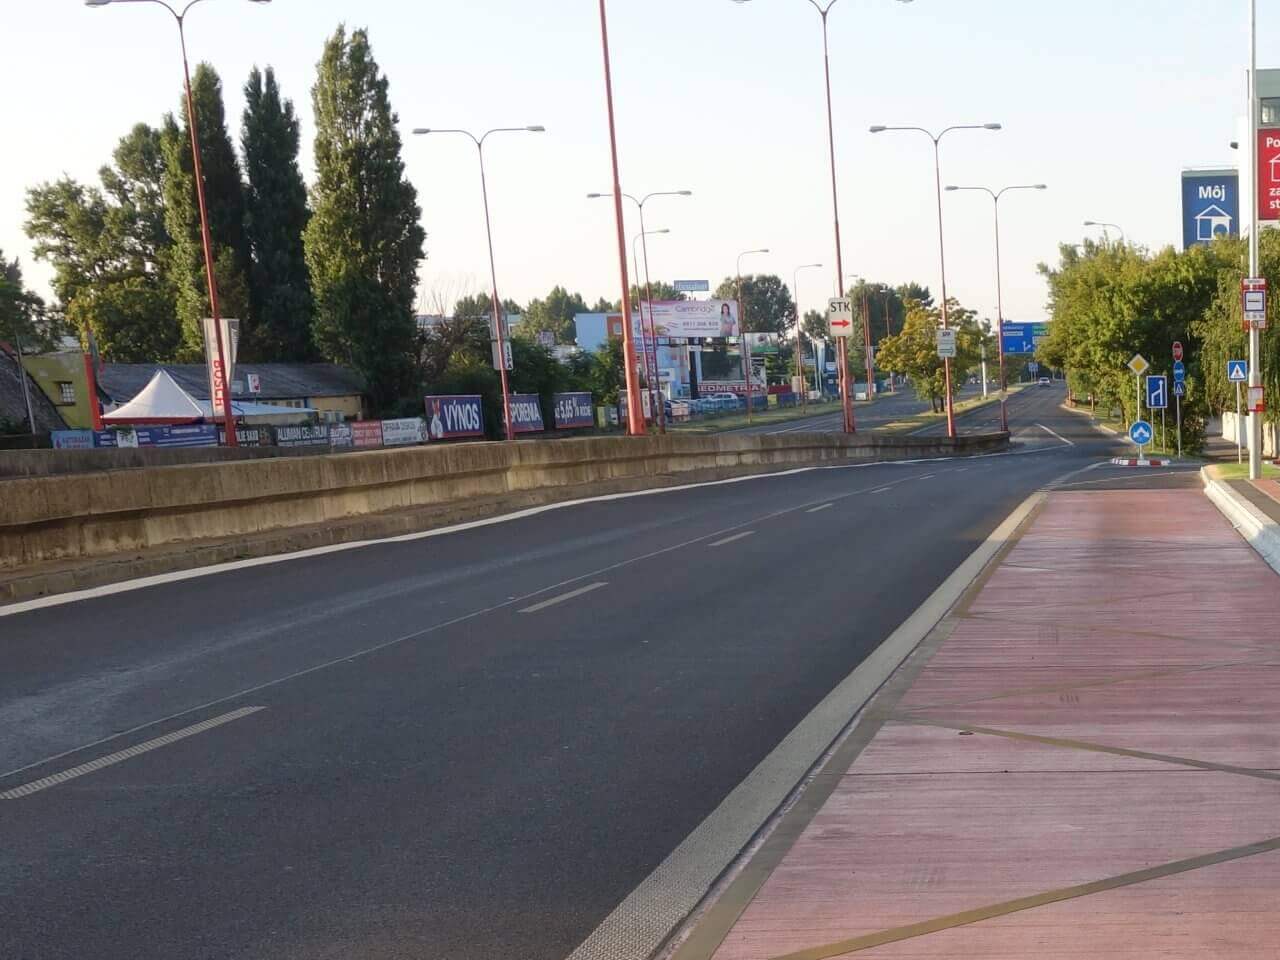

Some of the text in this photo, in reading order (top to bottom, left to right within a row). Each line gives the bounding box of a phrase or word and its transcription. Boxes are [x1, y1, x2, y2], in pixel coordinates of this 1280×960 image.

[1198, 185, 1226, 202] Môj
[830, 301, 851, 313] STK
[443, 399, 480, 432] VÝNOS
